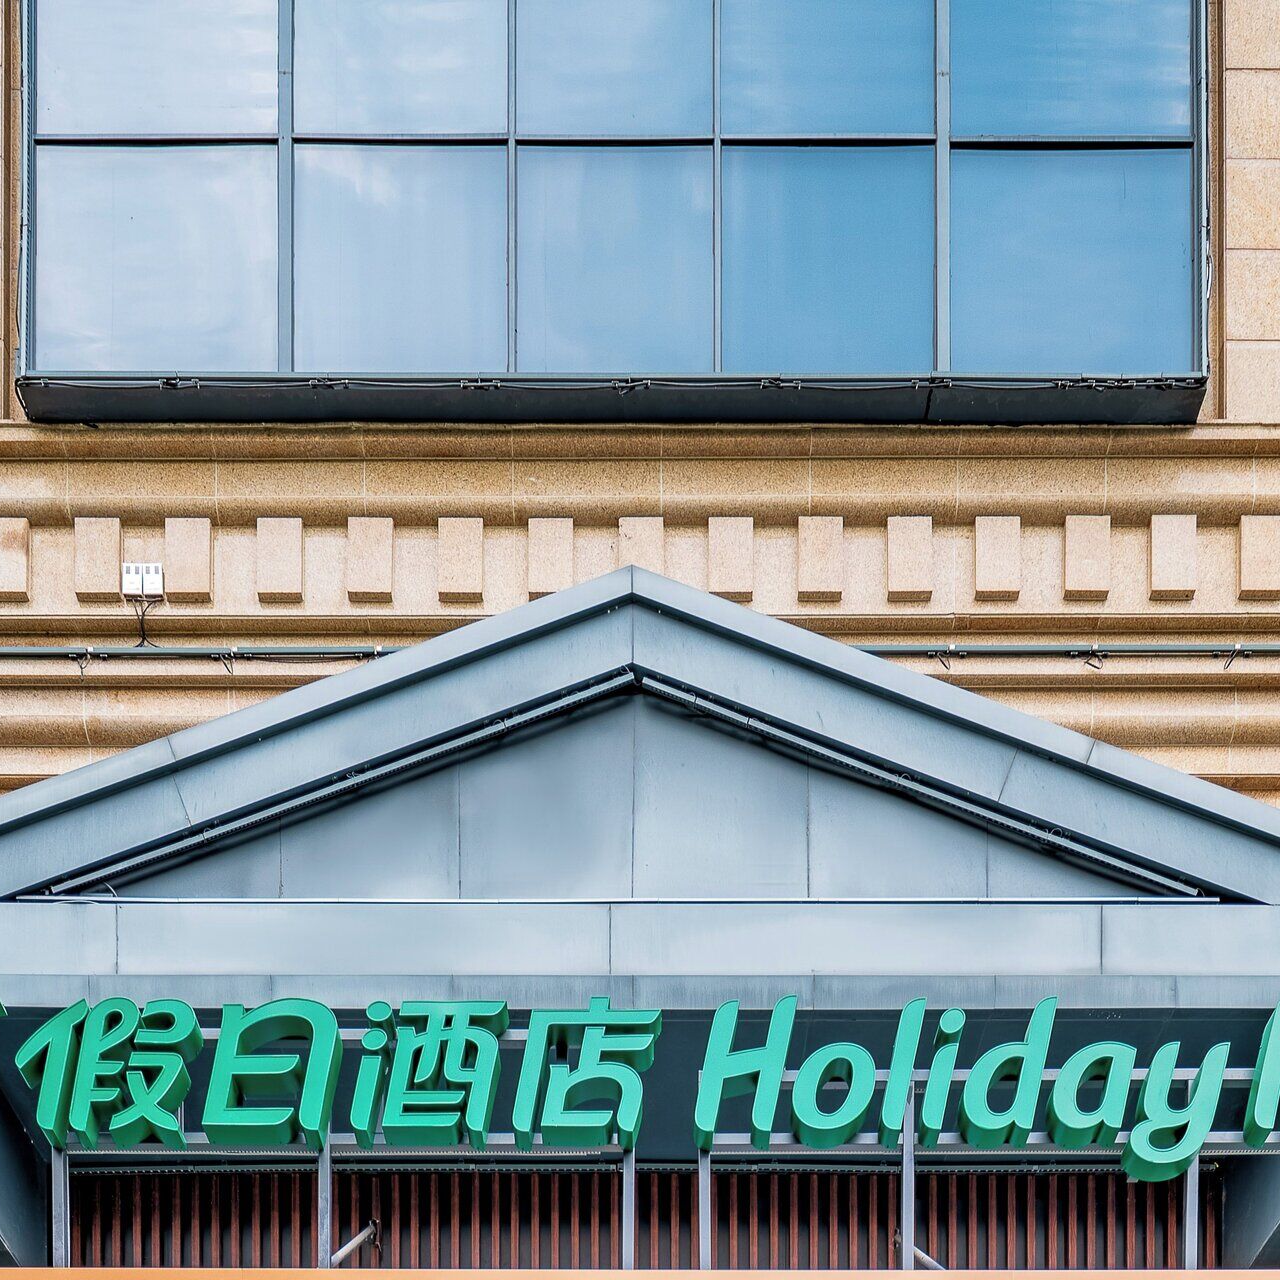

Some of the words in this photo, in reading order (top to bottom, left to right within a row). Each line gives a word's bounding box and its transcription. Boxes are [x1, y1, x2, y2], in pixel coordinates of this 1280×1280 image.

[15, 996, 662, 1150] 假日酒店
[693, 994, 1230, 1182] Holiday
